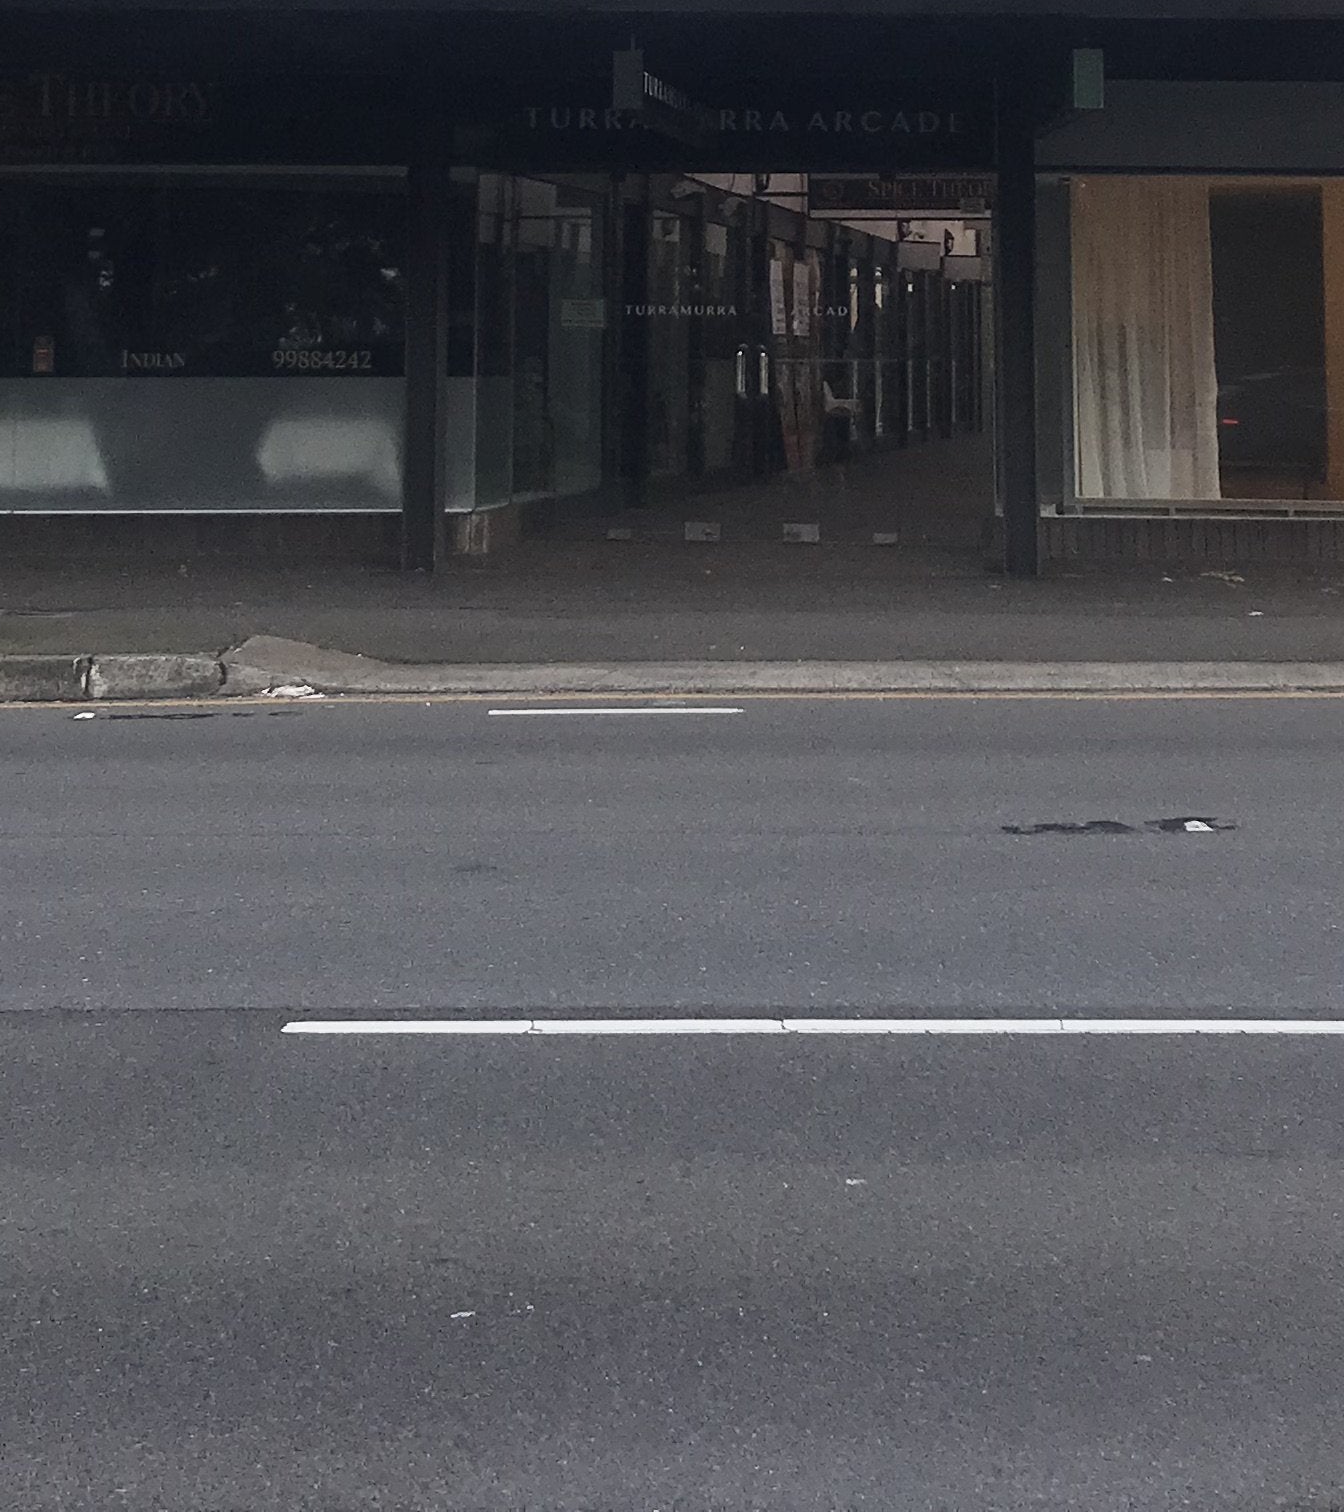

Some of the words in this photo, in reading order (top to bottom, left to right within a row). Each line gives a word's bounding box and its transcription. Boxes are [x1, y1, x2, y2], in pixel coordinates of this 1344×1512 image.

[807, 109, 961, 134] ARCADE
[625, 304, 738, 317] TURRAMURRA
[120, 349, 186, 369] INDIAN
[272, 349, 372, 369] 99884242
